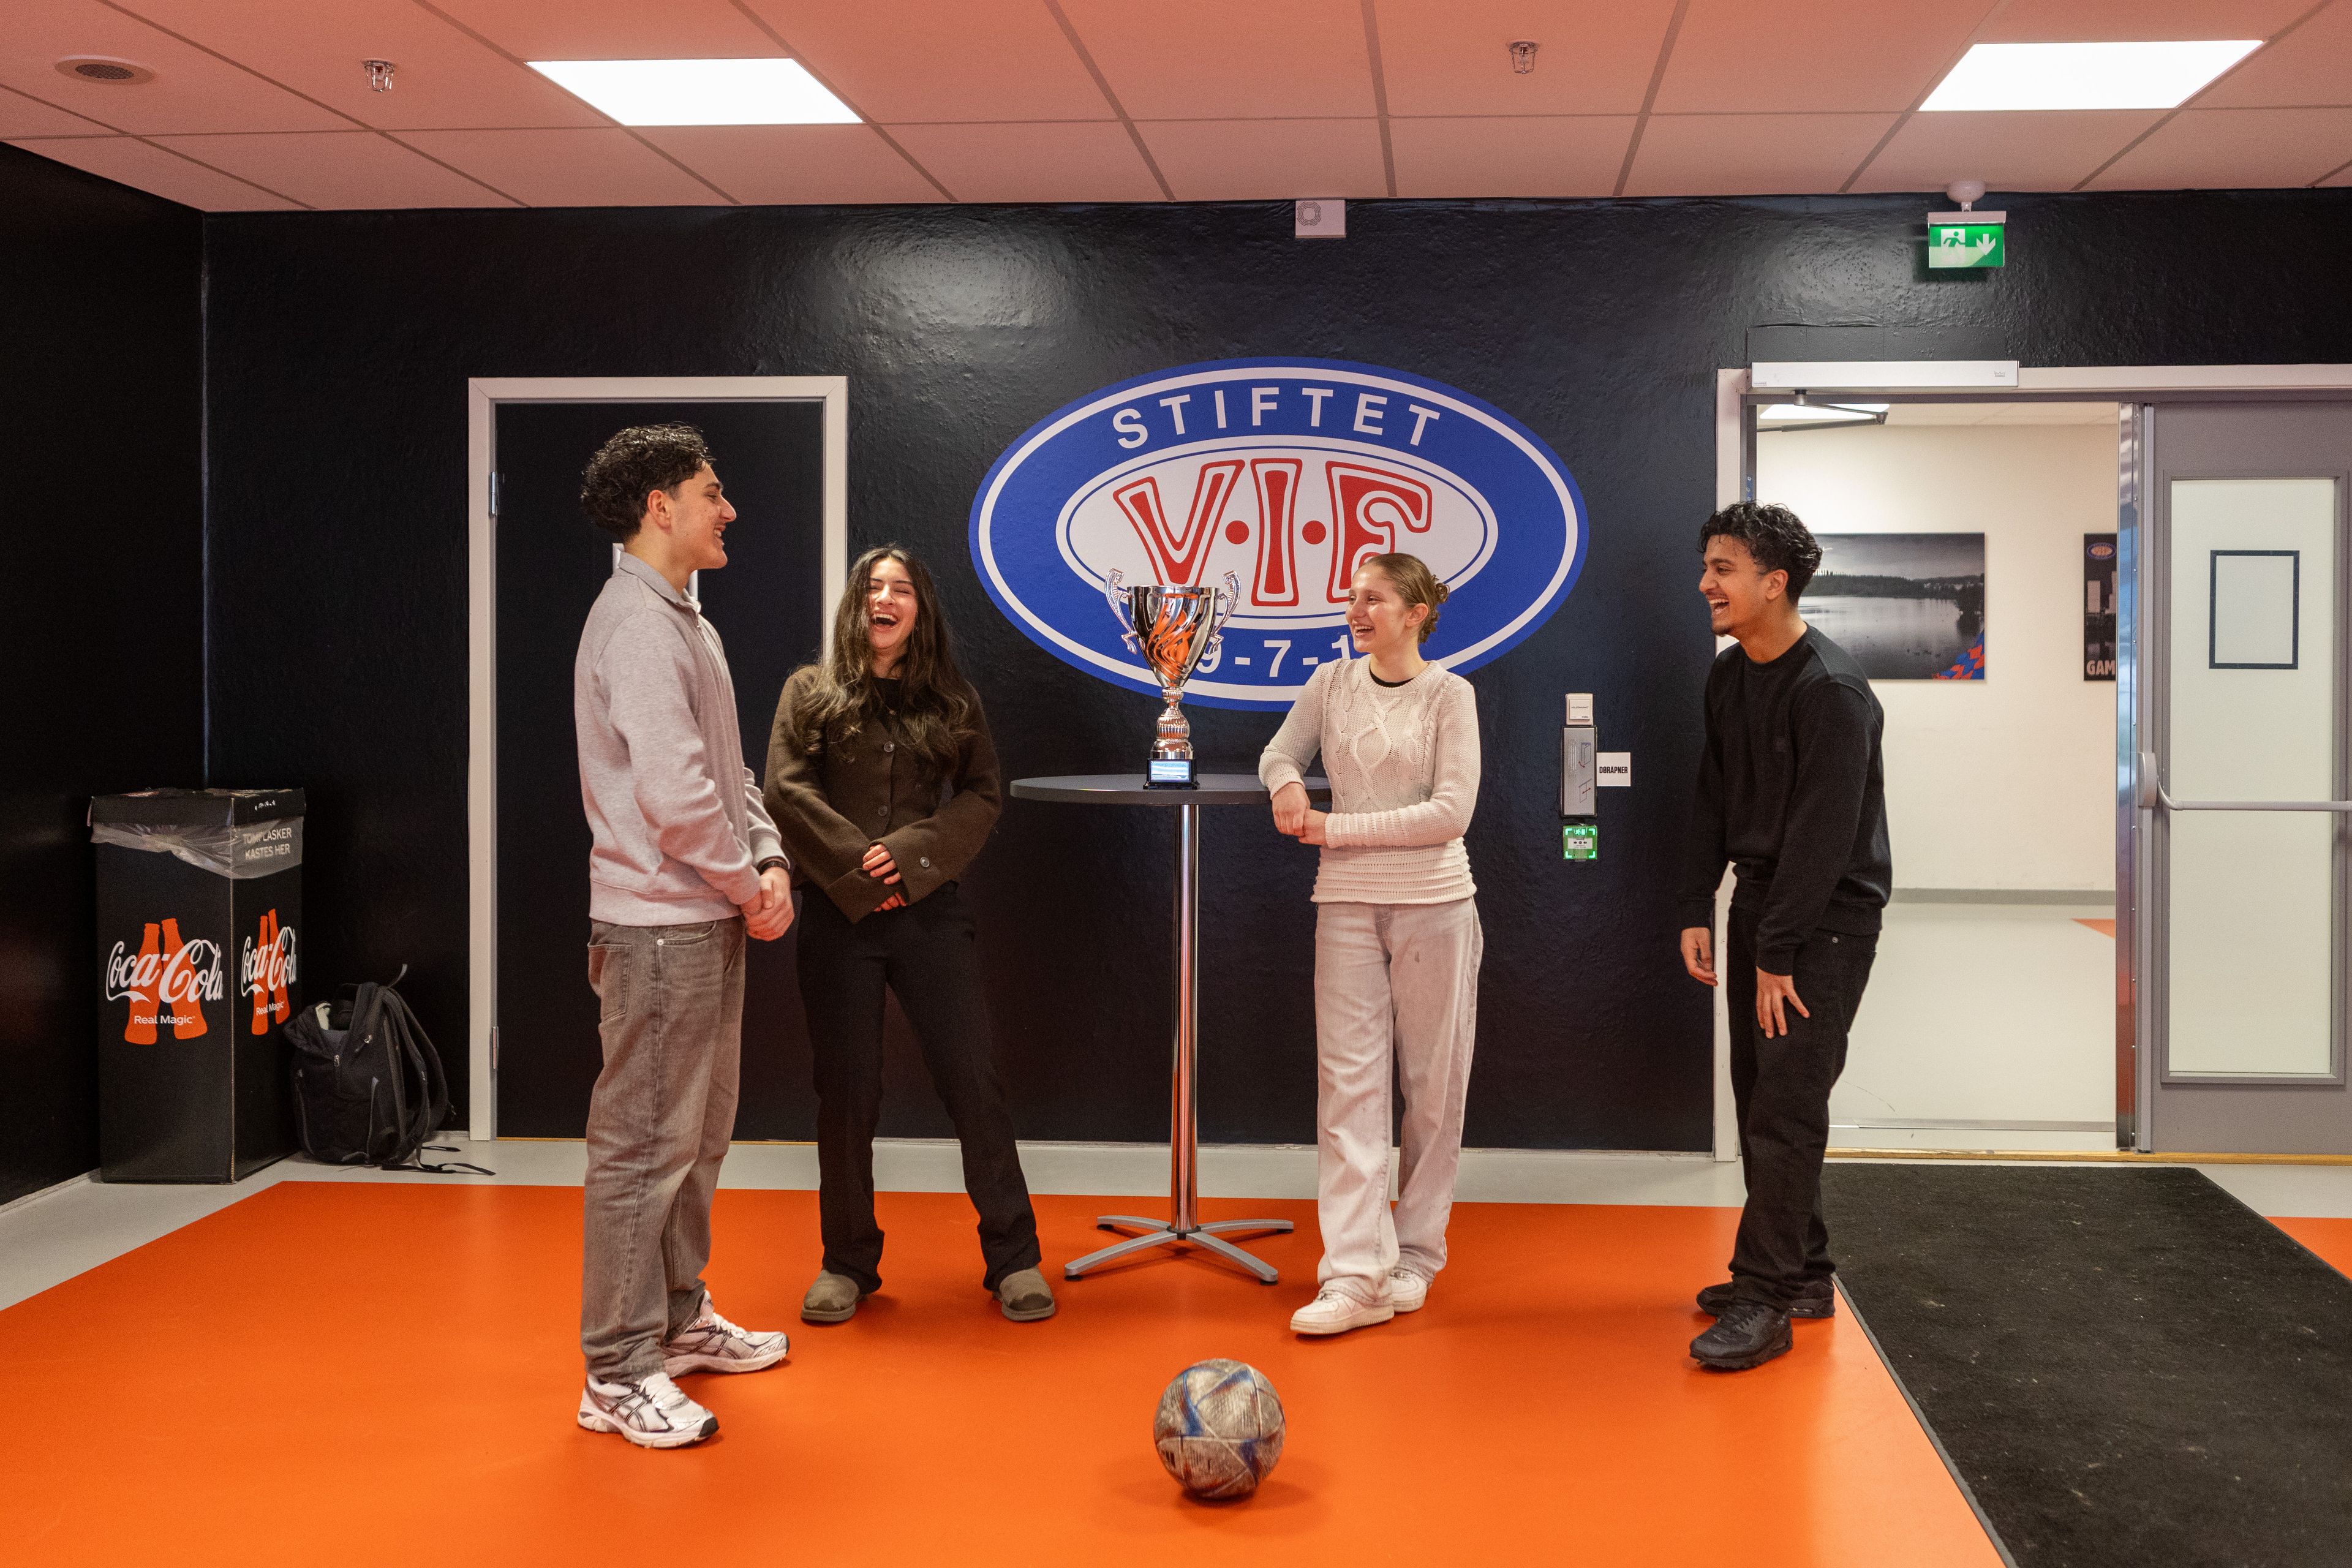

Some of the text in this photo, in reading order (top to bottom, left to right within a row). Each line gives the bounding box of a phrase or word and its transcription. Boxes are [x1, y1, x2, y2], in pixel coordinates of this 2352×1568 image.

[1112, 387, 1439, 449] STIFTET
[246, 843, 290, 859] KASTES HER
[106, 939, 223, 1003] Coca-Cola
[241, 926, 296, 997] Coca-Cola
[134, 1015, 193, 1026] Real Magic
[256, 1001, 284, 1016] Real Magic
